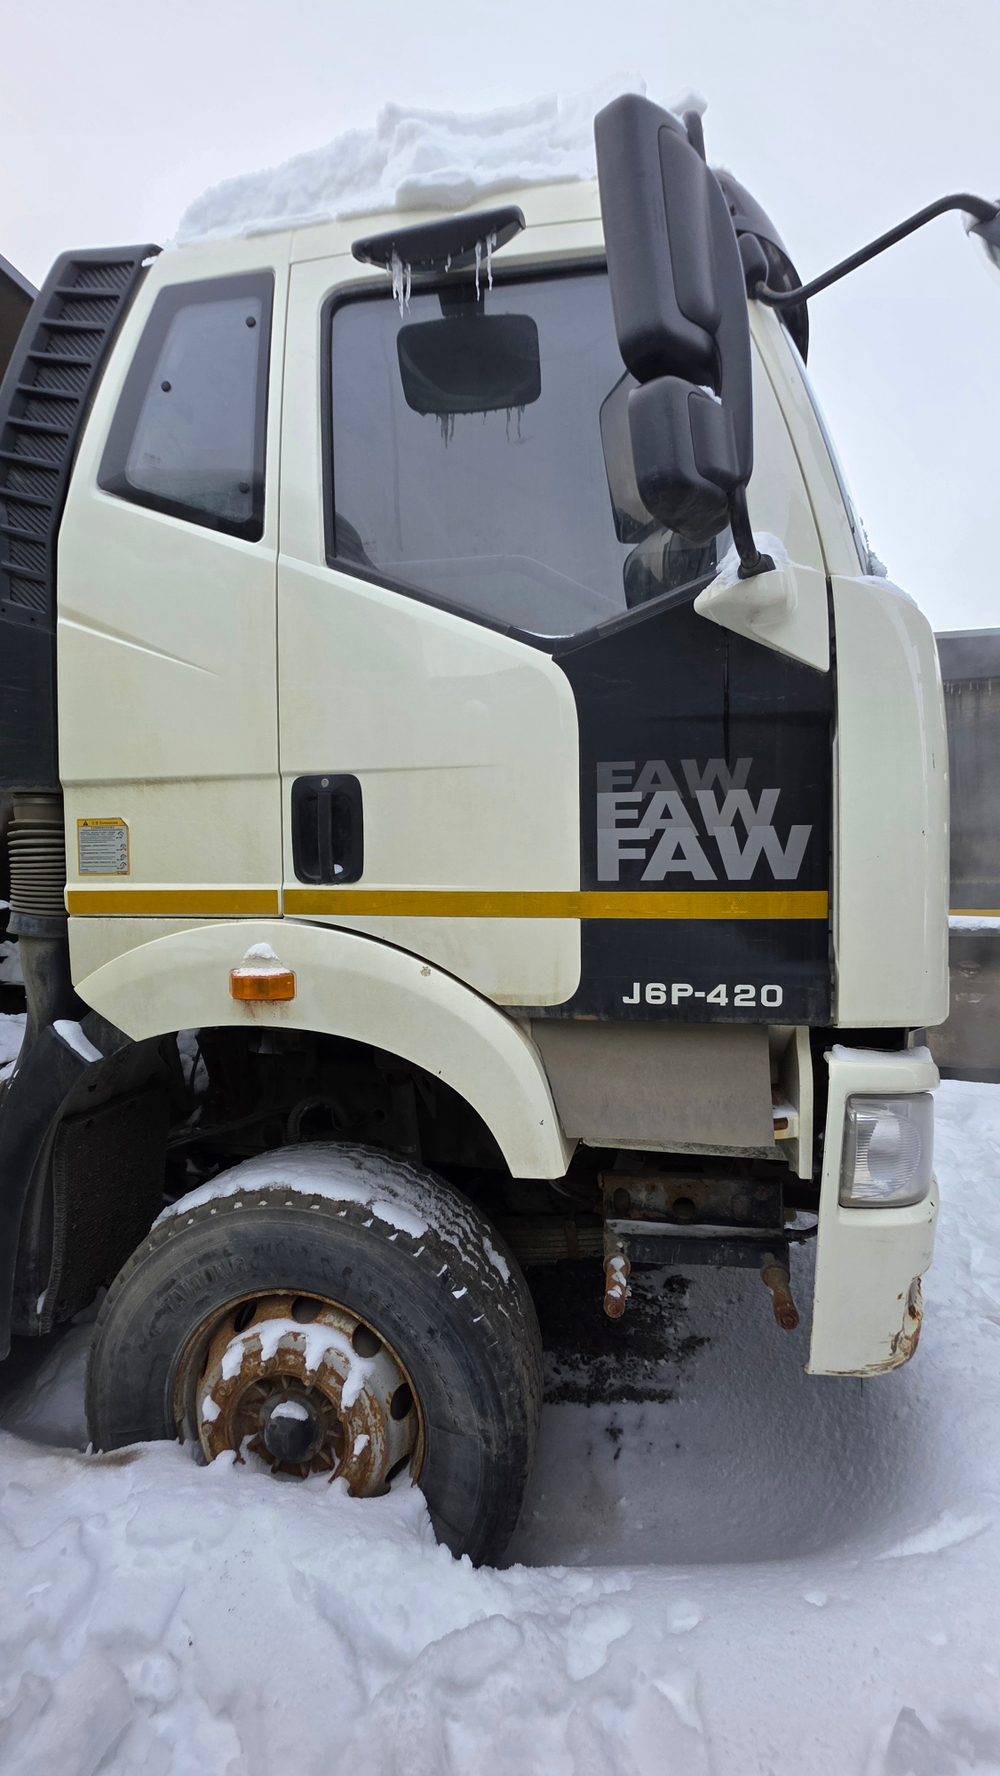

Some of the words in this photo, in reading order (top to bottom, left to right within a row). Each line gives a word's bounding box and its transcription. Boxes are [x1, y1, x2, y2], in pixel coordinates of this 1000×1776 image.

[596, 757, 753, 799] FAW
[596, 788, 781, 837] FAW
[597, 825, 813, 881] FAW
[622, 982, 783, 1007] J6P-420
